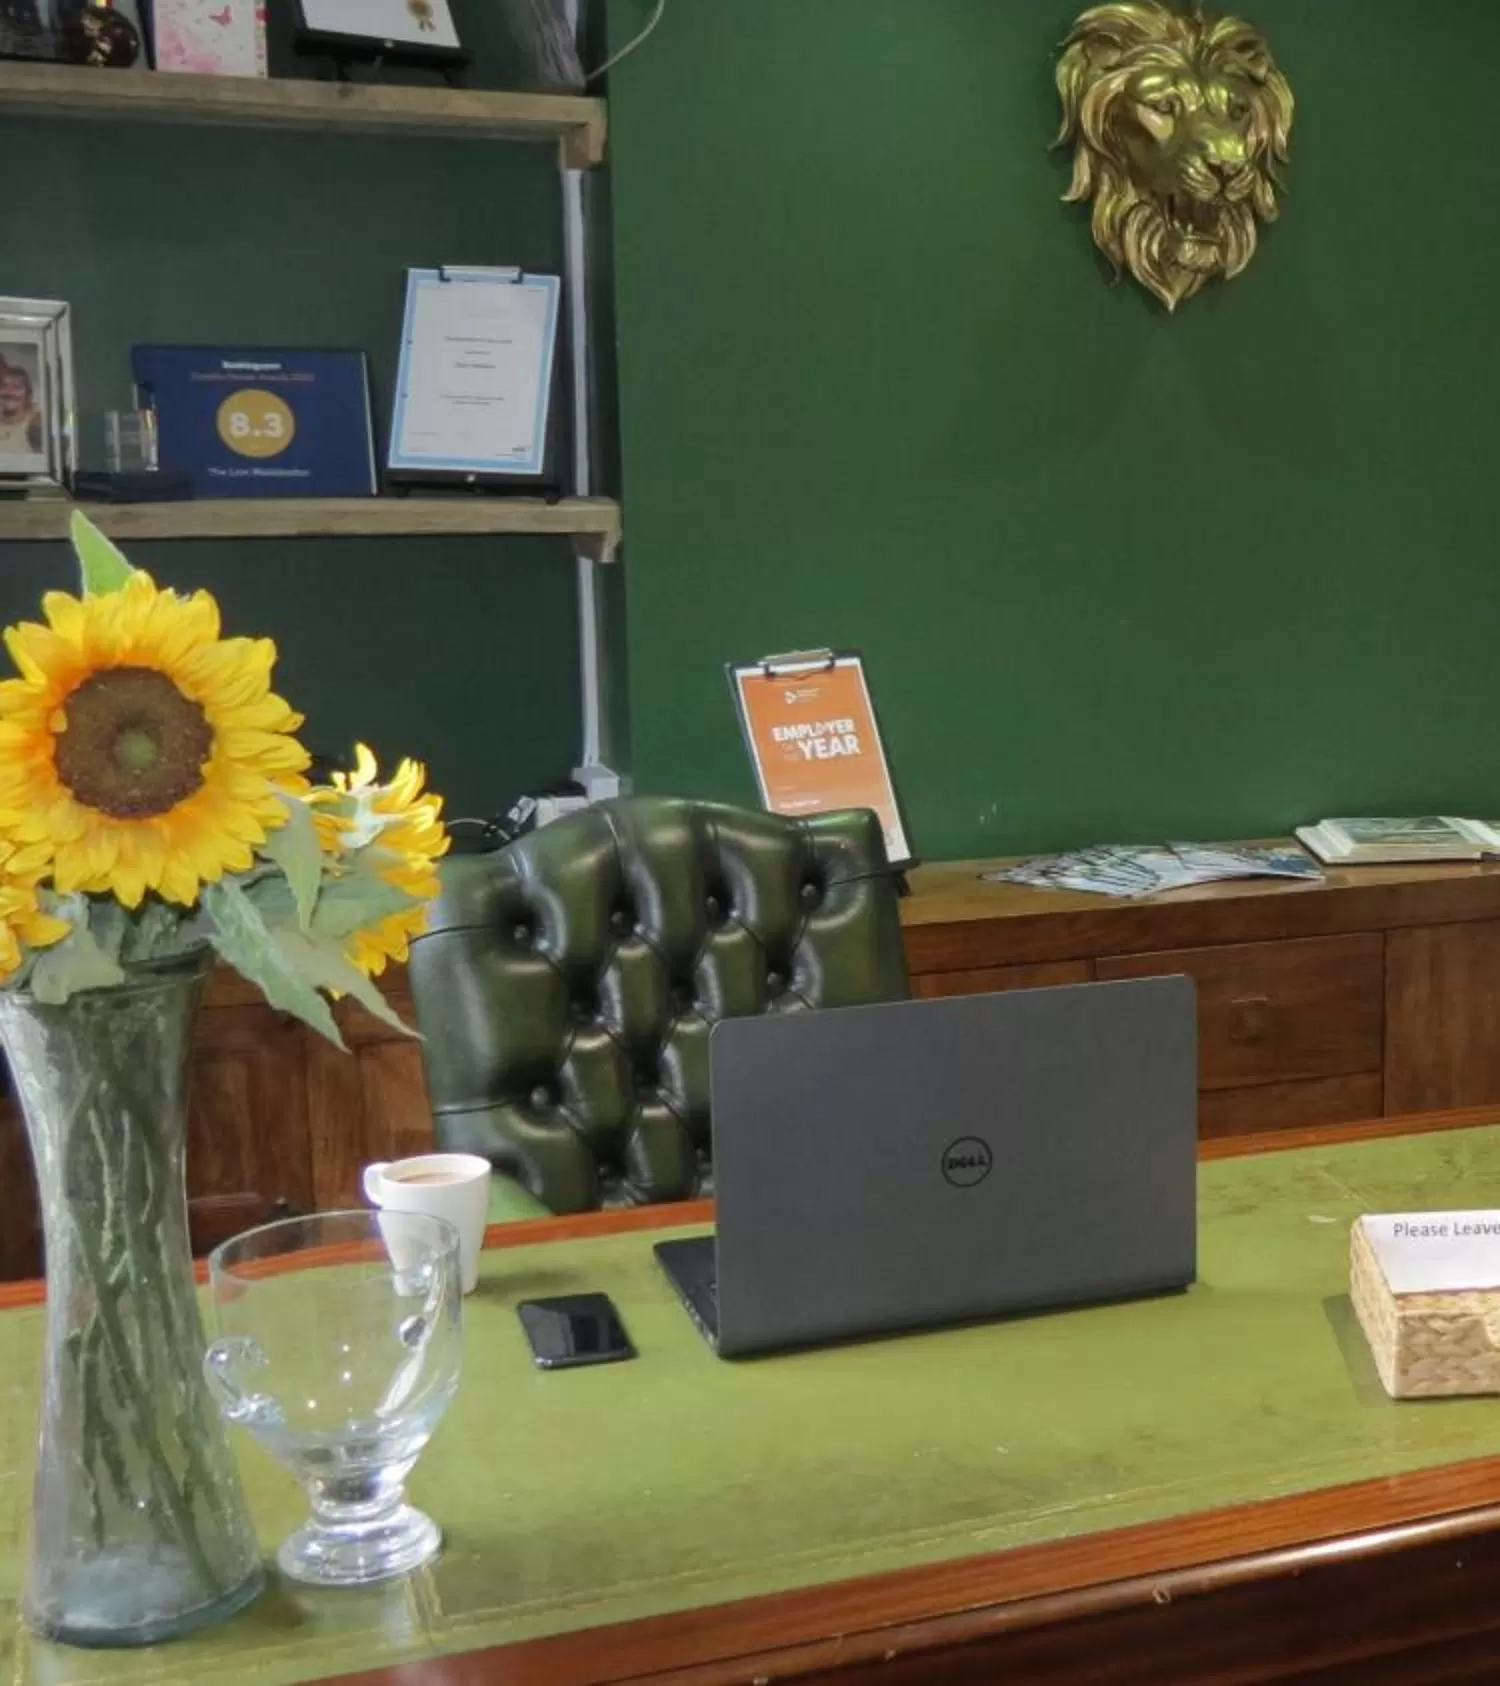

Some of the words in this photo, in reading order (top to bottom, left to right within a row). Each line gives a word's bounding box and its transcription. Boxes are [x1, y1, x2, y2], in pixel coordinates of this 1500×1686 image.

[230, 411, 283, 438] 8.3
[771, 718, 856, 742] EMPLOYER
[797, 733, 864, 760] YEAR
[947, 1155, 989, 1170] DELL
[1393, 1221, 1449, 1238] Please
